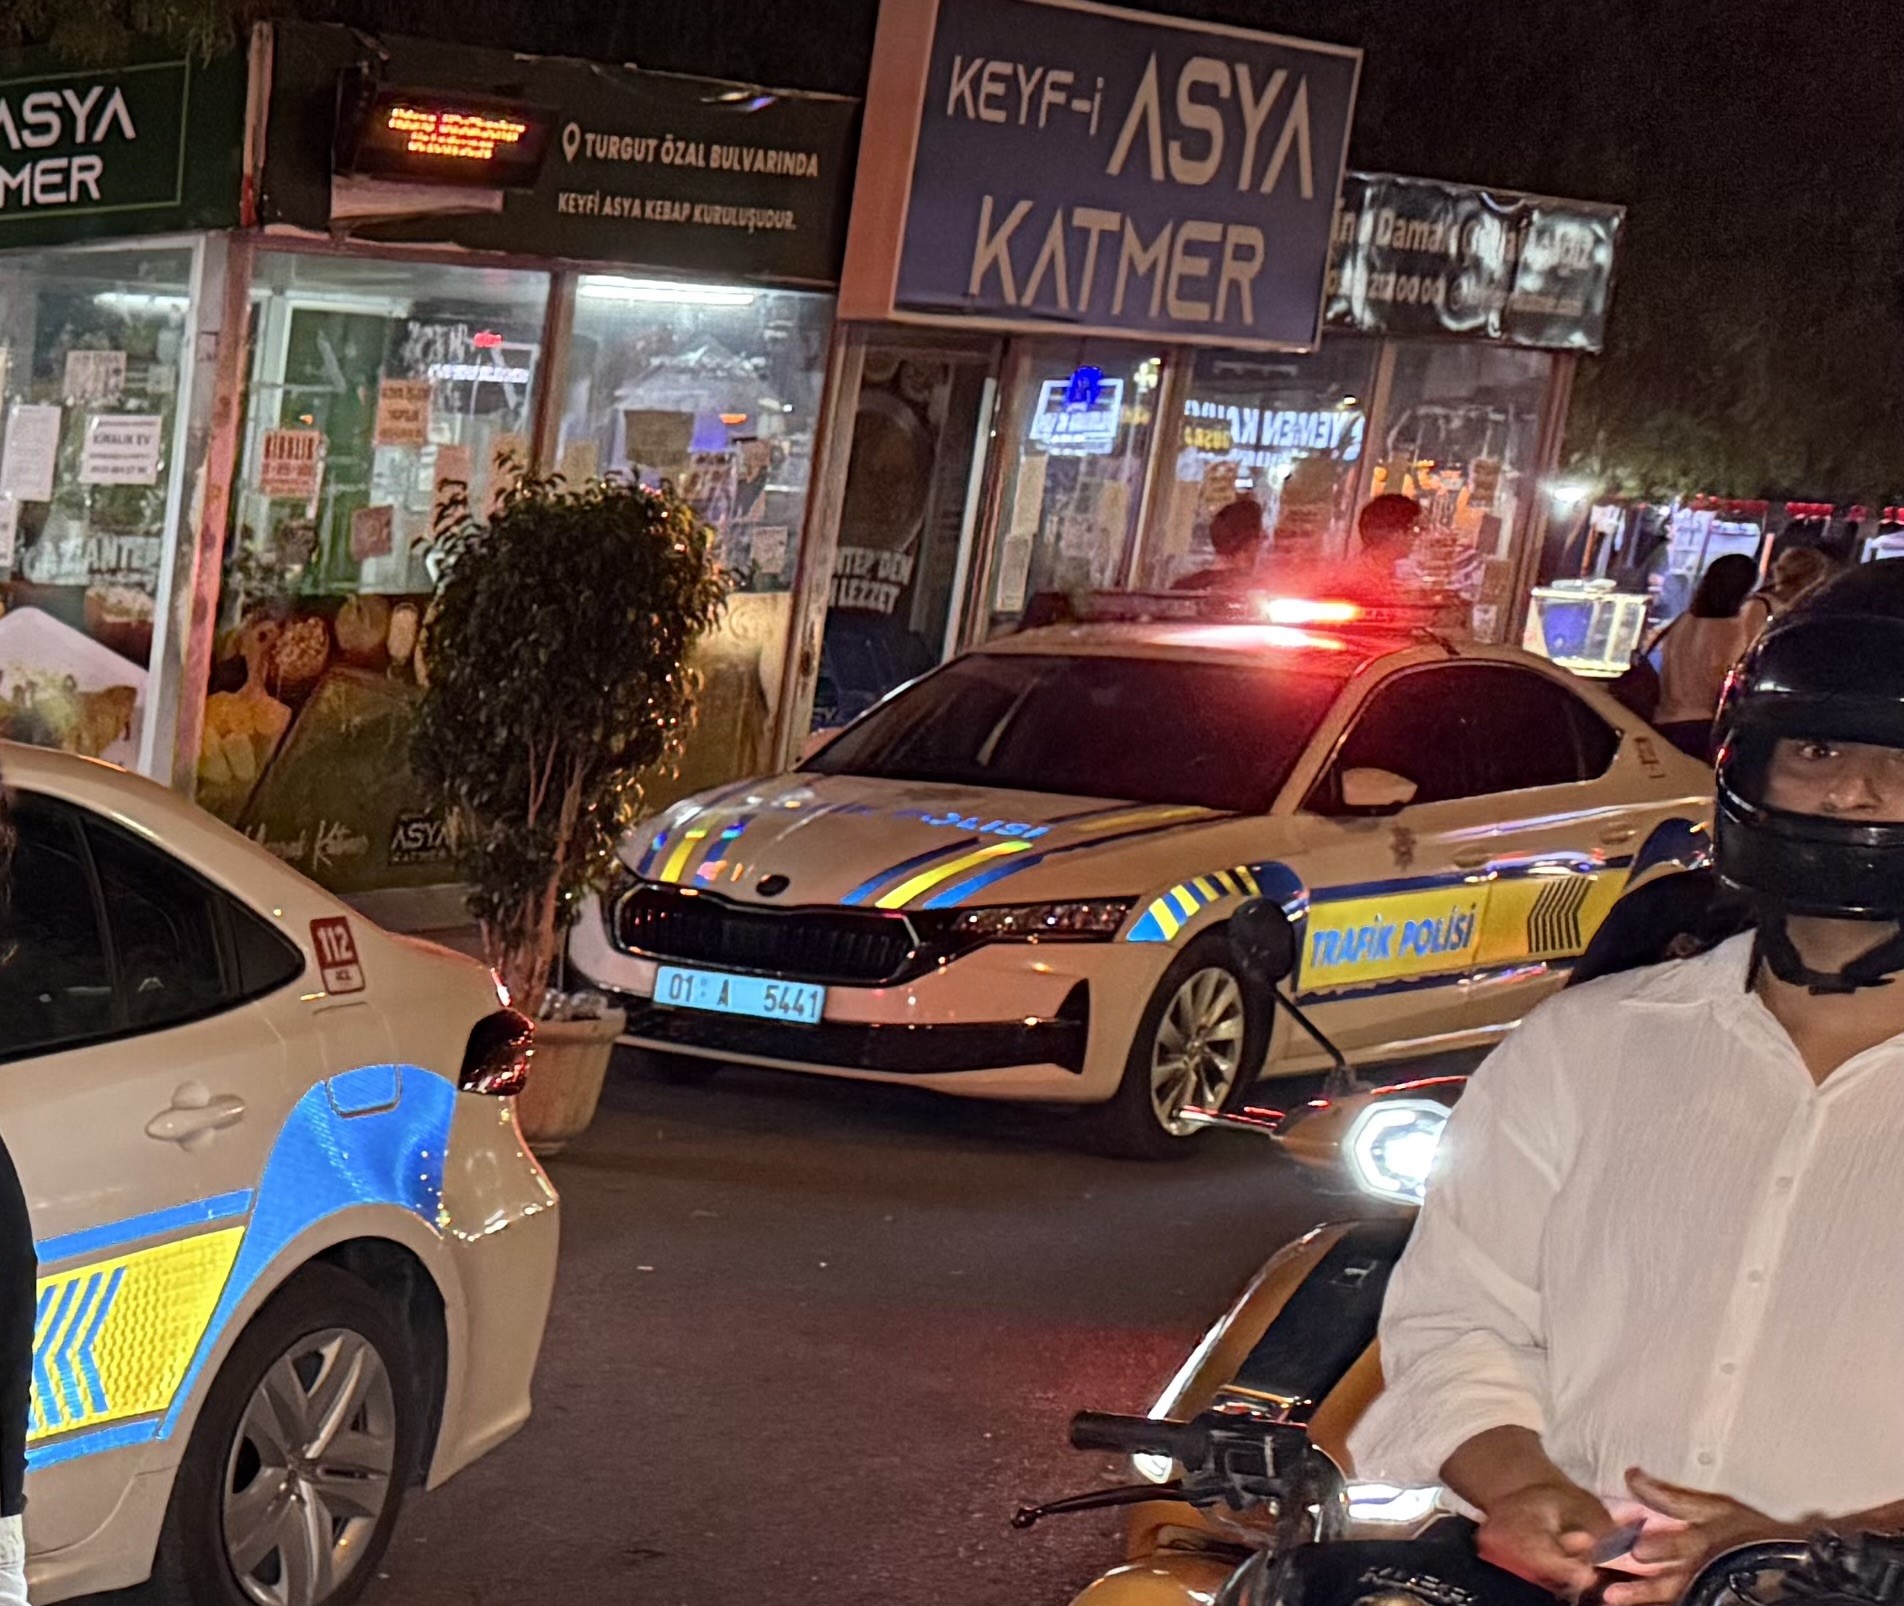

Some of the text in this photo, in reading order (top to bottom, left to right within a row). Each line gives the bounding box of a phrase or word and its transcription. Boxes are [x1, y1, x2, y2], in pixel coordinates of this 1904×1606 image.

[1106, 48, 1313, 200] ASYA
[584, 133, 819, 177] TURGUT ÖZAL BULVARINDA
[602, 196, 641, 219] ASYA
[969, 195, 1264, 325] KATMER
[316, 925, 353, 963] 112
[669, 973, 819, 1018] 01 A 5441
